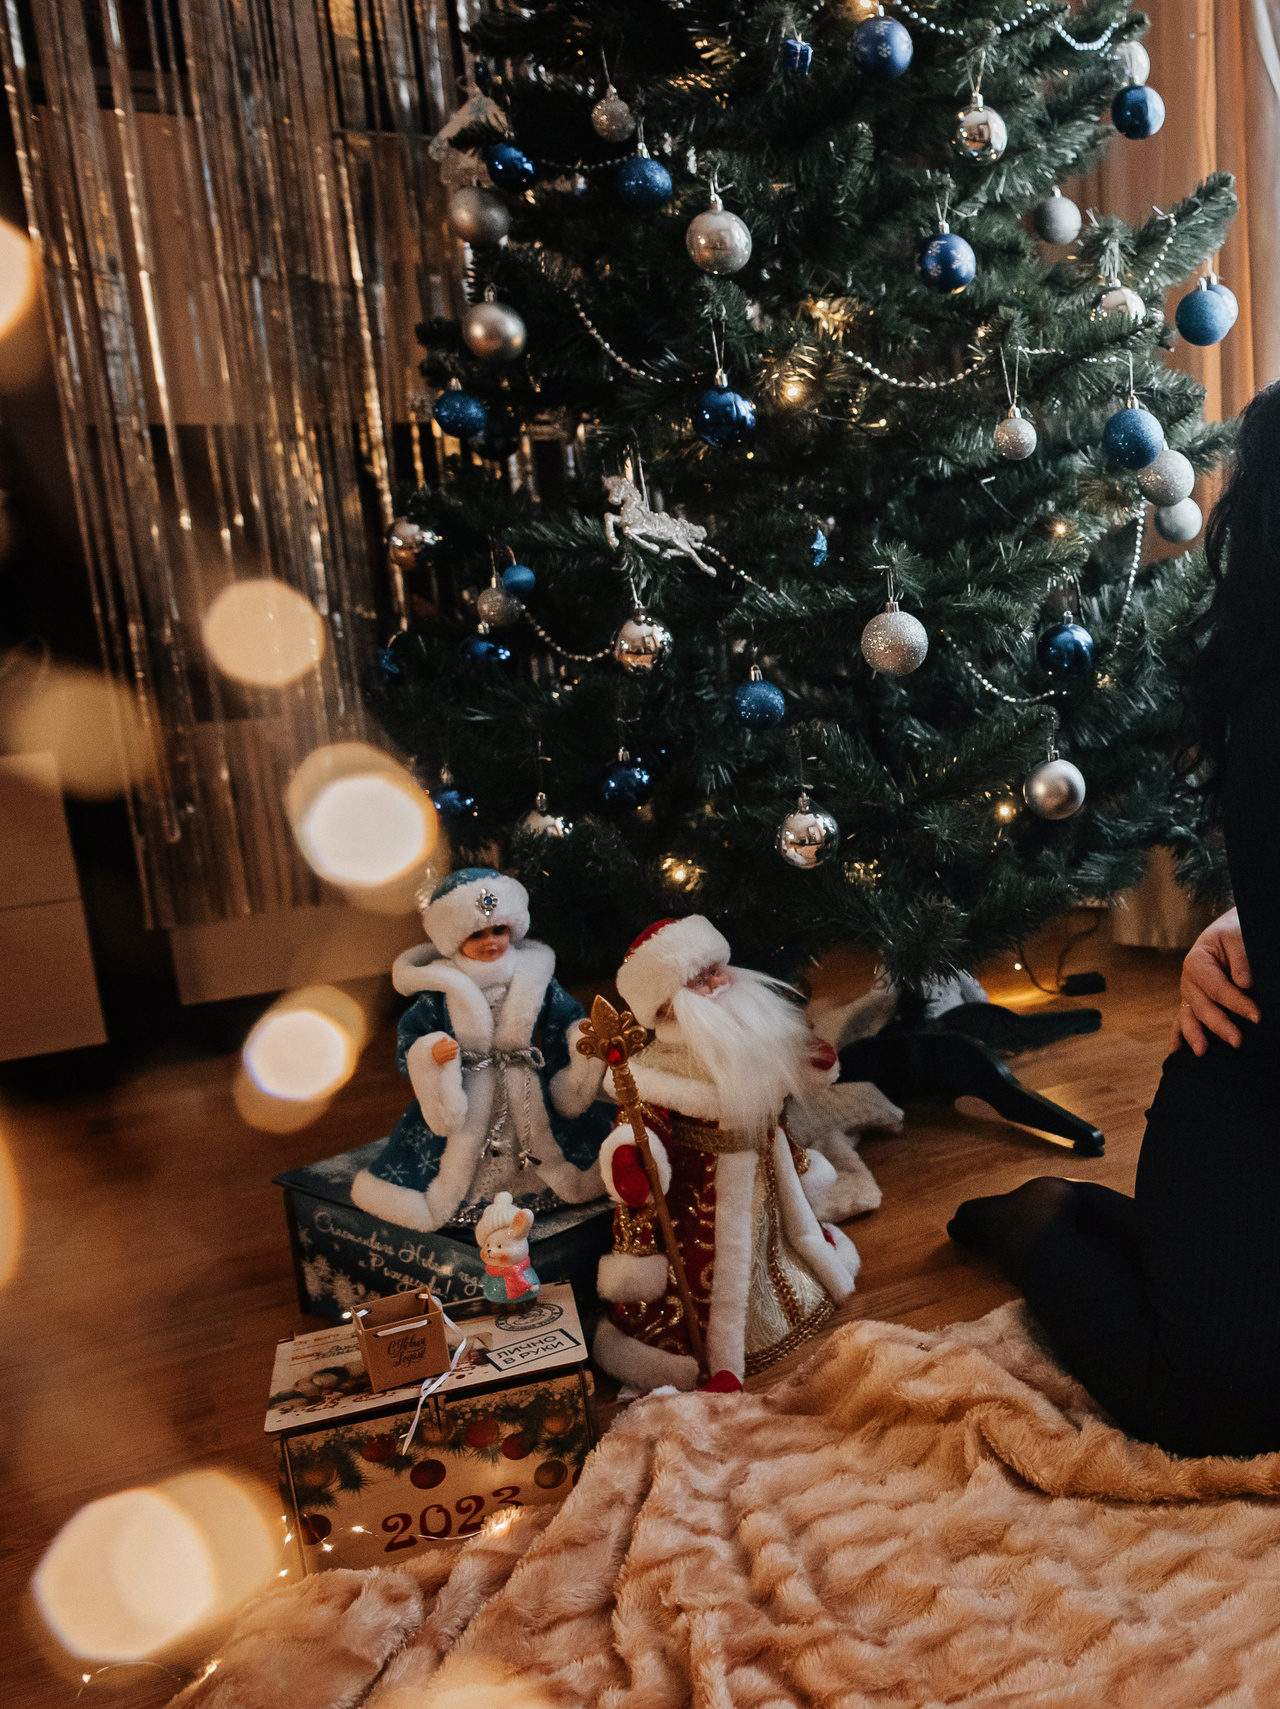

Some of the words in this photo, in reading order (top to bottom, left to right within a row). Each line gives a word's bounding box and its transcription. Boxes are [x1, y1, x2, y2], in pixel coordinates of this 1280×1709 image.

[496, 1335, 557, 1359] ЛИЧНО
[502, 1357, 516, 1365] В
[519, 1341, 565, 1359] РУКИ
